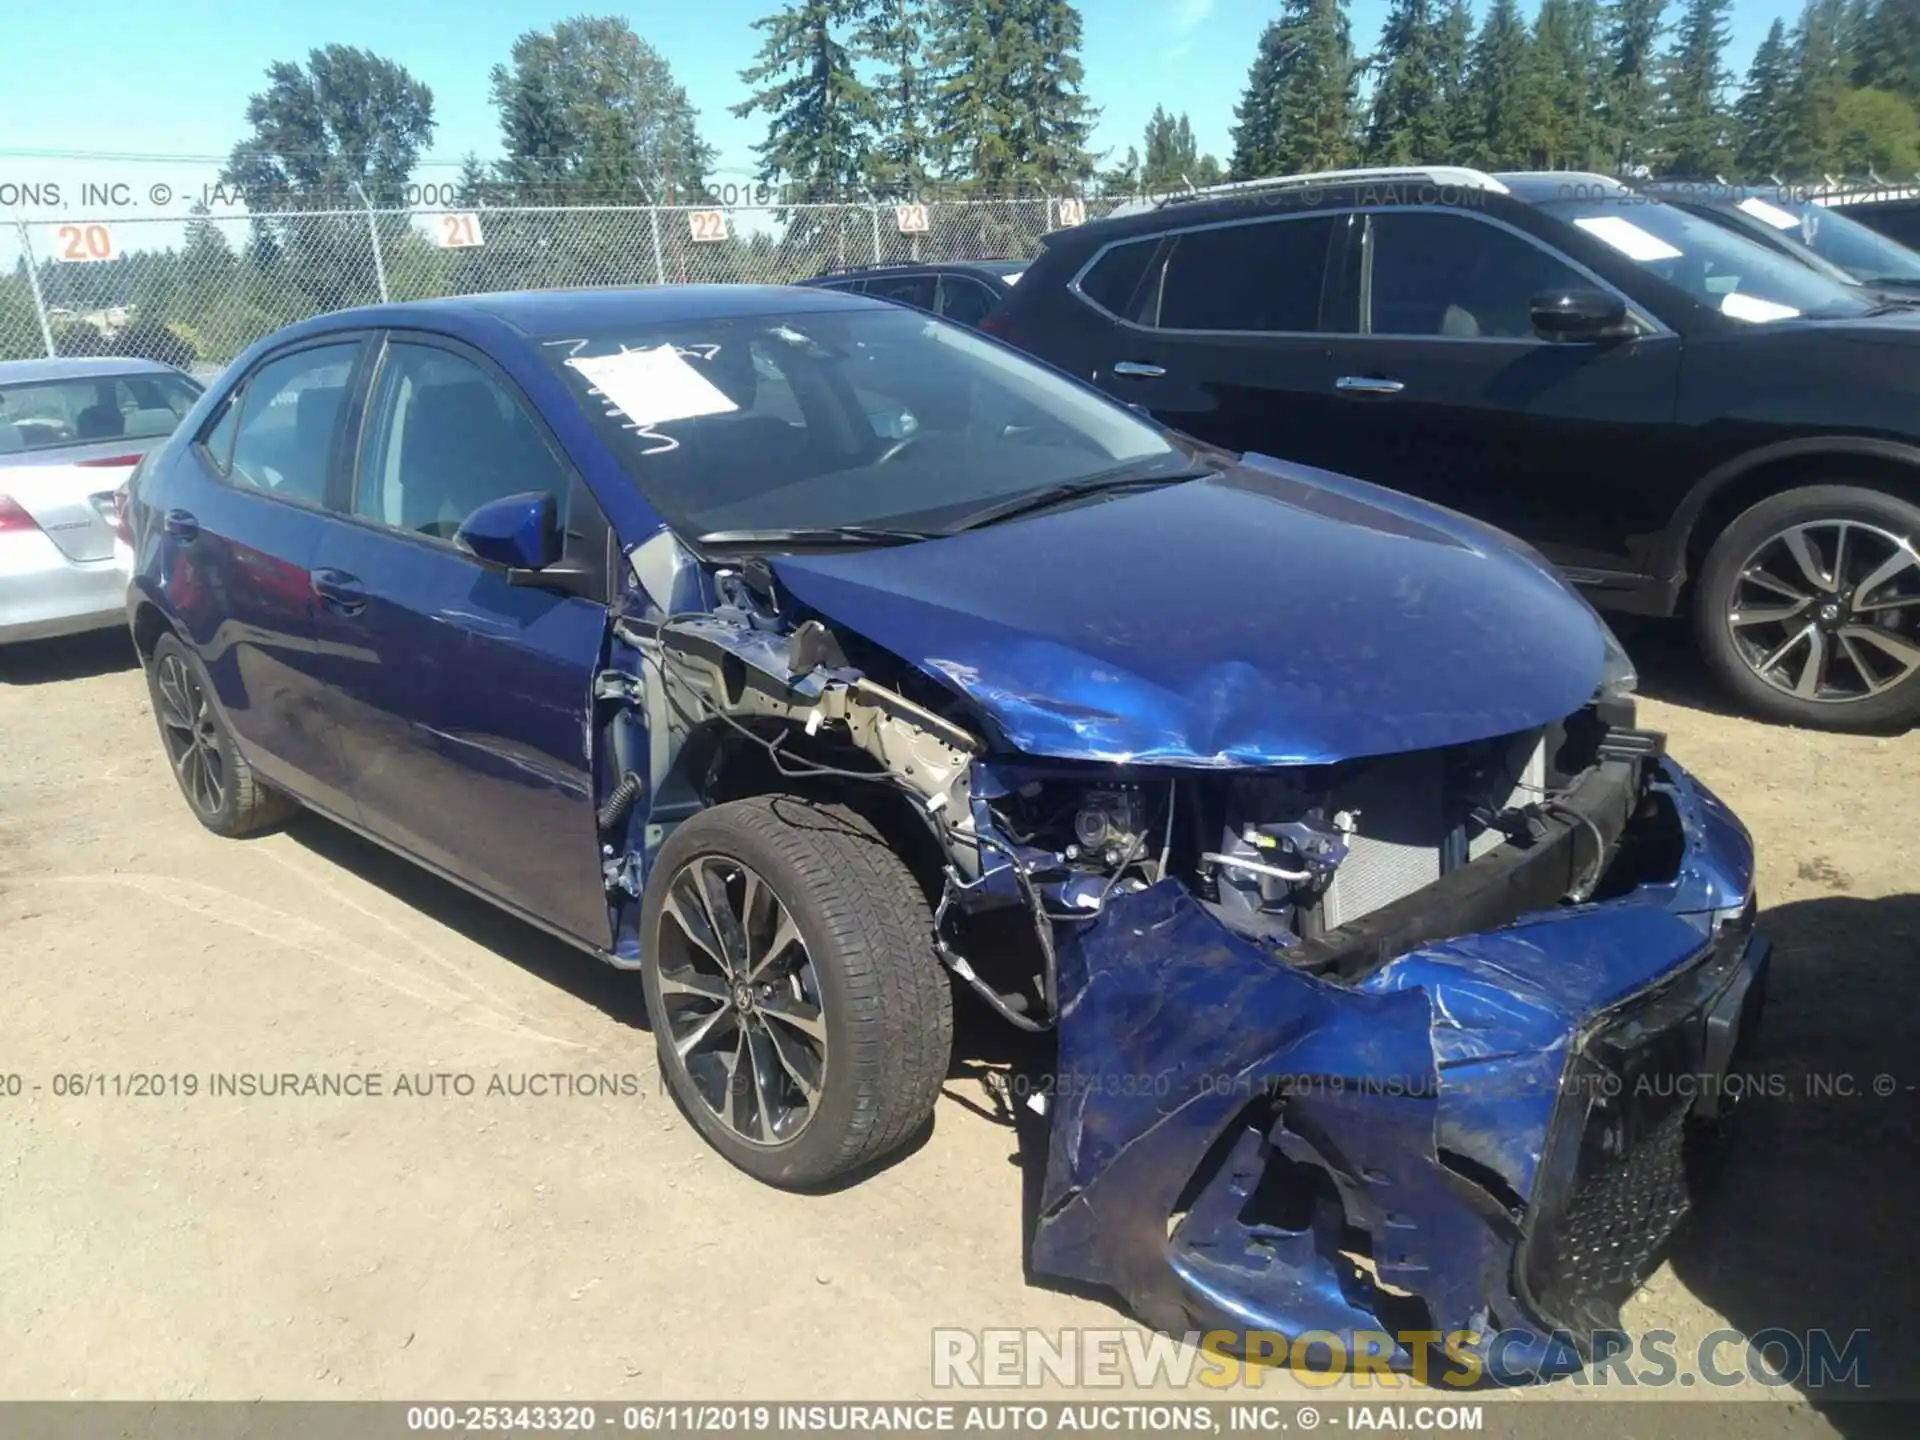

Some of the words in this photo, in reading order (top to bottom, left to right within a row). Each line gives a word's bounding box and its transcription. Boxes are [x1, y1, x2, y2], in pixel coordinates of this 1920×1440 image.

[443, 216, 476, 245] 21
[694, 212, 724, 239] 22
[900, 206, 925, 229] 23
[59, 225, 111, 259] 20
